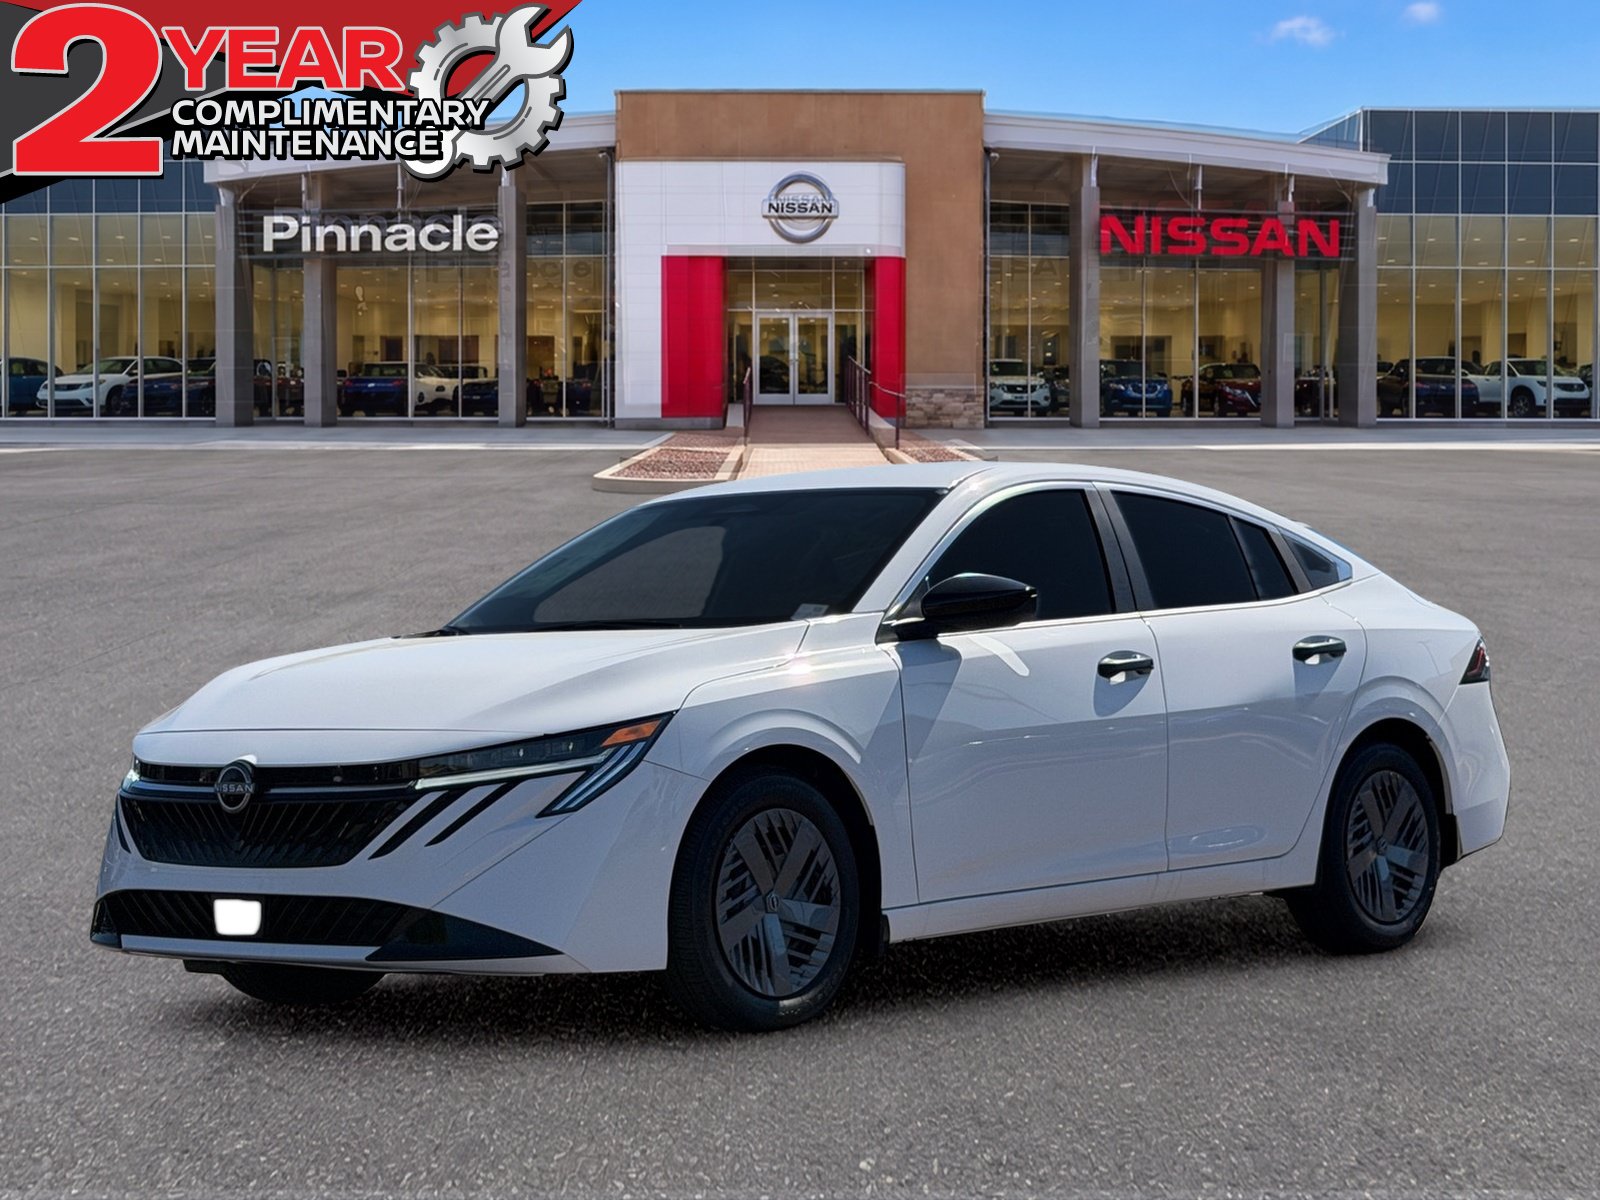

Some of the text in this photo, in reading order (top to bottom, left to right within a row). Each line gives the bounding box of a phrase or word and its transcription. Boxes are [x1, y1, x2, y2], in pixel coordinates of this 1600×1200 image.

[768, 202, 833, 214] NISSAN
[263, 215, 499, 253] Pinnacle
[1099, 215, 1340, 257] NISSAN
